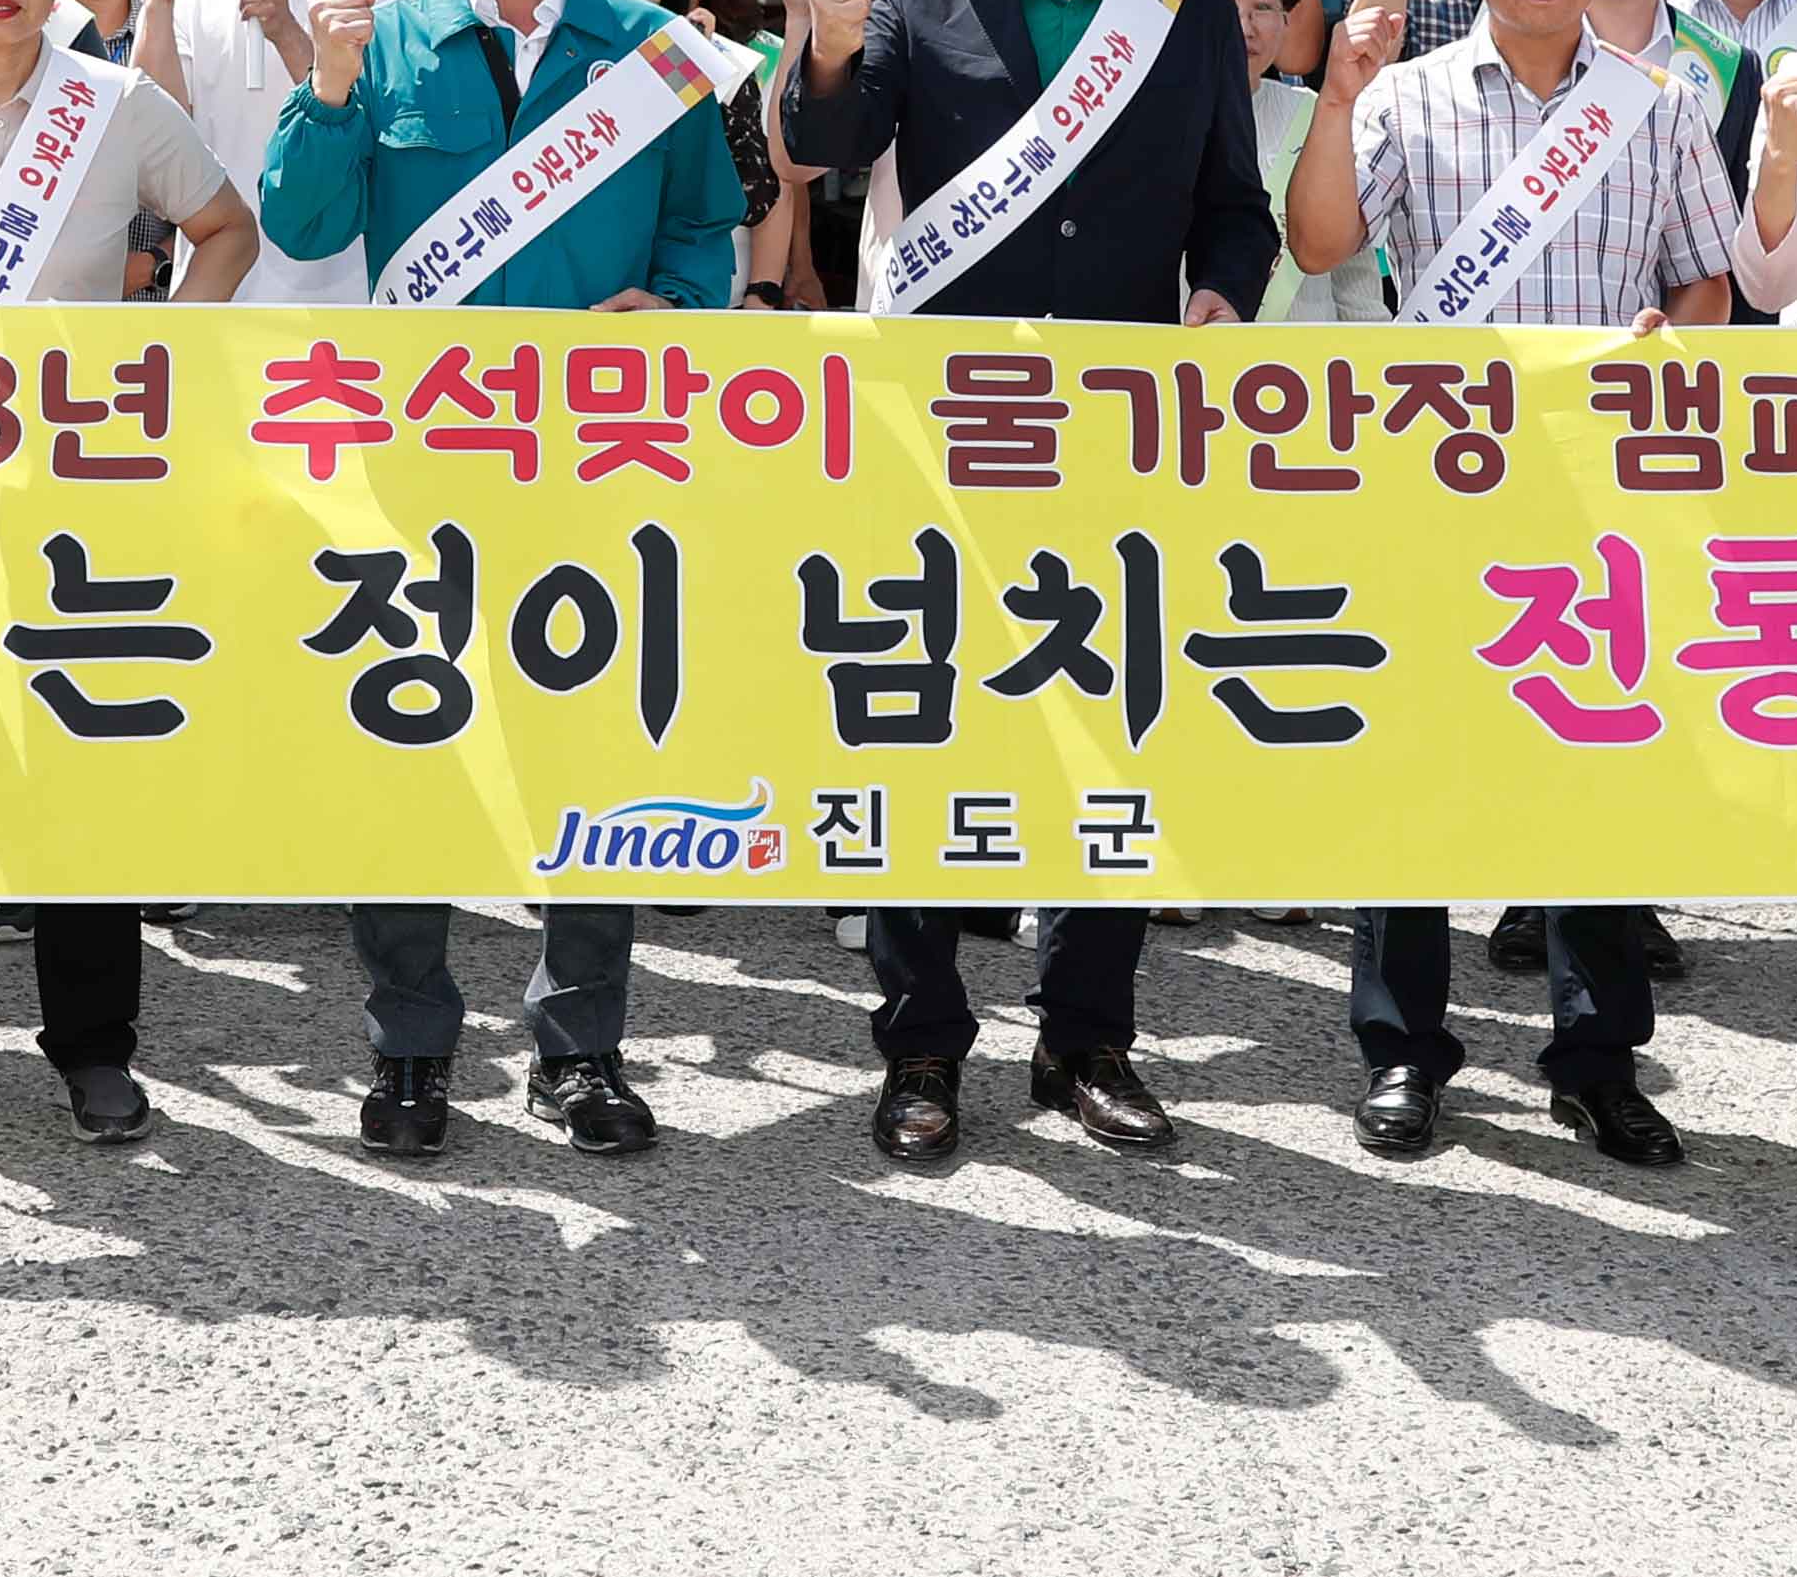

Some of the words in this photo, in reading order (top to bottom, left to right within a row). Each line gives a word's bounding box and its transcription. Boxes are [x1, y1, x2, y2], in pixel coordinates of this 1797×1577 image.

[1051, 28, 1139, 144] 추석맞이
[512, 107, 621, 212] 추석맞이
[1522, 101, 1616, 214] 추석맞이
[250, 340, 855, 485] 추석맞이
[929, 352, 1515, 495] 물가안정
[301, 520, 684, 749] 정이
[798, 524, 1389, 750] 넘치는
[536, 811, 741, 871] Jindo
[812, 789, 1157, 869] 진도군
